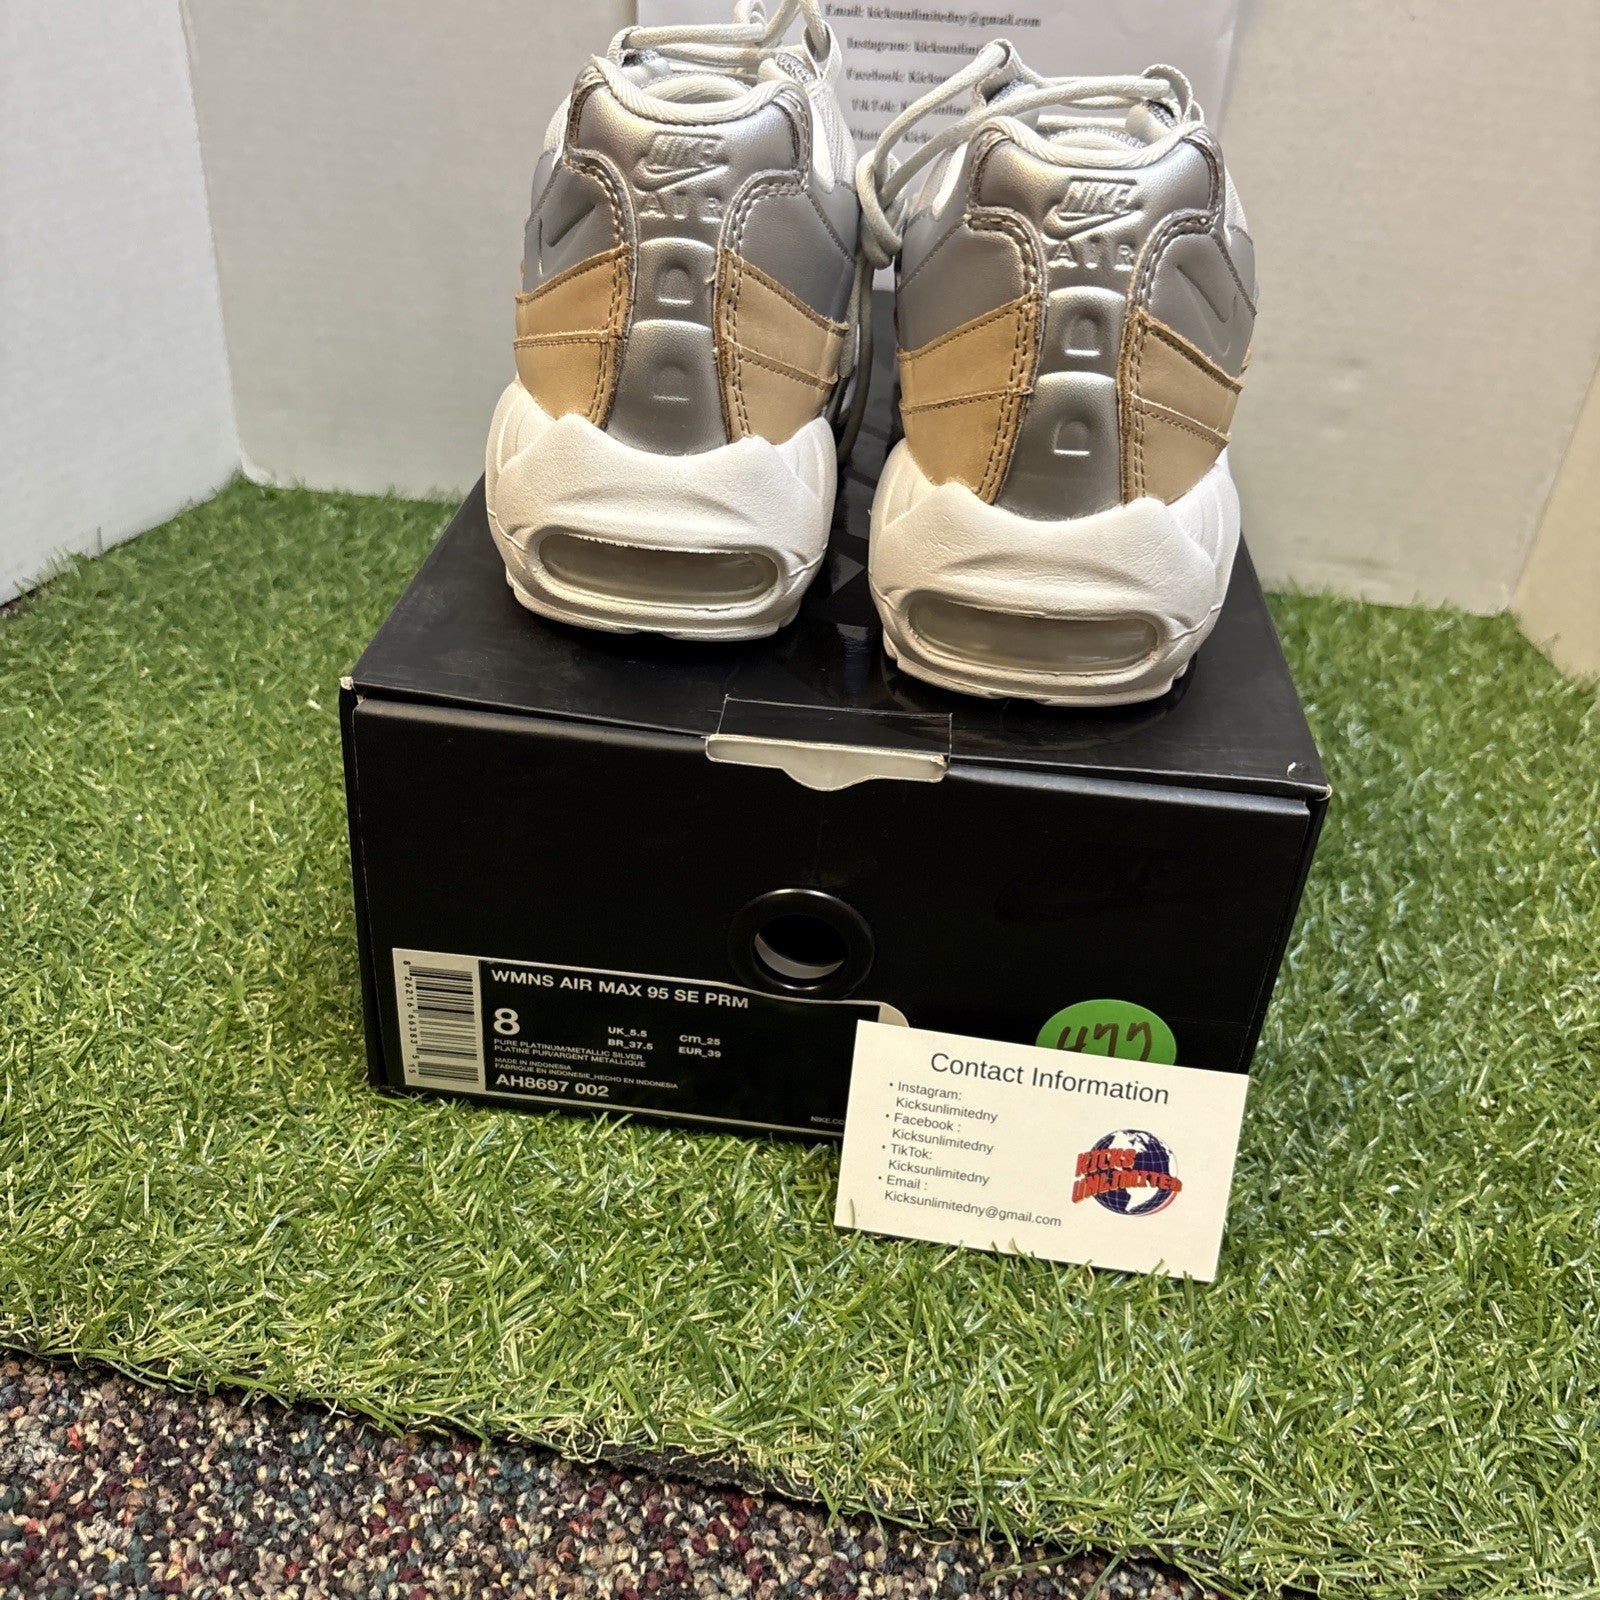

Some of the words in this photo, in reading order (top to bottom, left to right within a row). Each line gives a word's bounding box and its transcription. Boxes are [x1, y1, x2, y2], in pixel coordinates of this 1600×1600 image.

[639, 193, 723, 222] AIR
[1060, 180, 1138, 212] NIKE
[1046, 240, 1136, 270] AIR
[491, 969, 554, 987] WMNS
[559, 976, 592, 991] AIR
[598, 980, 643, 997] MAX
[647, 986, 669, 1000] 95
[674, 989, 700, 1003] SE
[704, 992, 749, 1009] PRM
[493, 1007, 520, 1036] 8
[607, 1026, 648, 1038] UK_5.5
[493, 1038, 518, 1047] PURE
[612, 1050, 643, 1061] SILVER
[607, 1038, 654, 1051] BR_37.5
[678, 1046, 722, 1058] EUR_39
[1056, 1021, 1152, 1062] 477
[494, 1057, 518, 1065] MADE
[529, 1060, 572, 1071] INDONESIA
[590, 1055, 647, 1068] METALLIQUE
[494, 1063, 535, 1073] FABRIQUE
[623, 1077, 635, 1085] EN
[636, 1078, 679, 1090] INDONESIA
[496, 1073, 570, 1093] AH8697
[574, 1082, 610, 1098] 002
[930, 1052, 1025, 1085] Contact
[1031, 1066, 1170, 1105] Information
[897, 1081, 962, 1101] Instagram:
[894, 1112, 954, 1132] Facebook
[895, 1096, 999, 1124] Kicksunlimitedny
[890, 1143, 933, 1160] TikTok:
[891, 1127, 995, 1156] Kicksunlimitedny
[888, 1158, 991, 1187] Kicksunlimitedny
[1074, 1147, 1137, 1178] KICKS
[886, 1174, 921, 1190] Email
[1071, 1168, 1183, 1204] UNLIMITED
[884, 1189, 1062, 1228] Kicksunlimitedny@gmail.com
